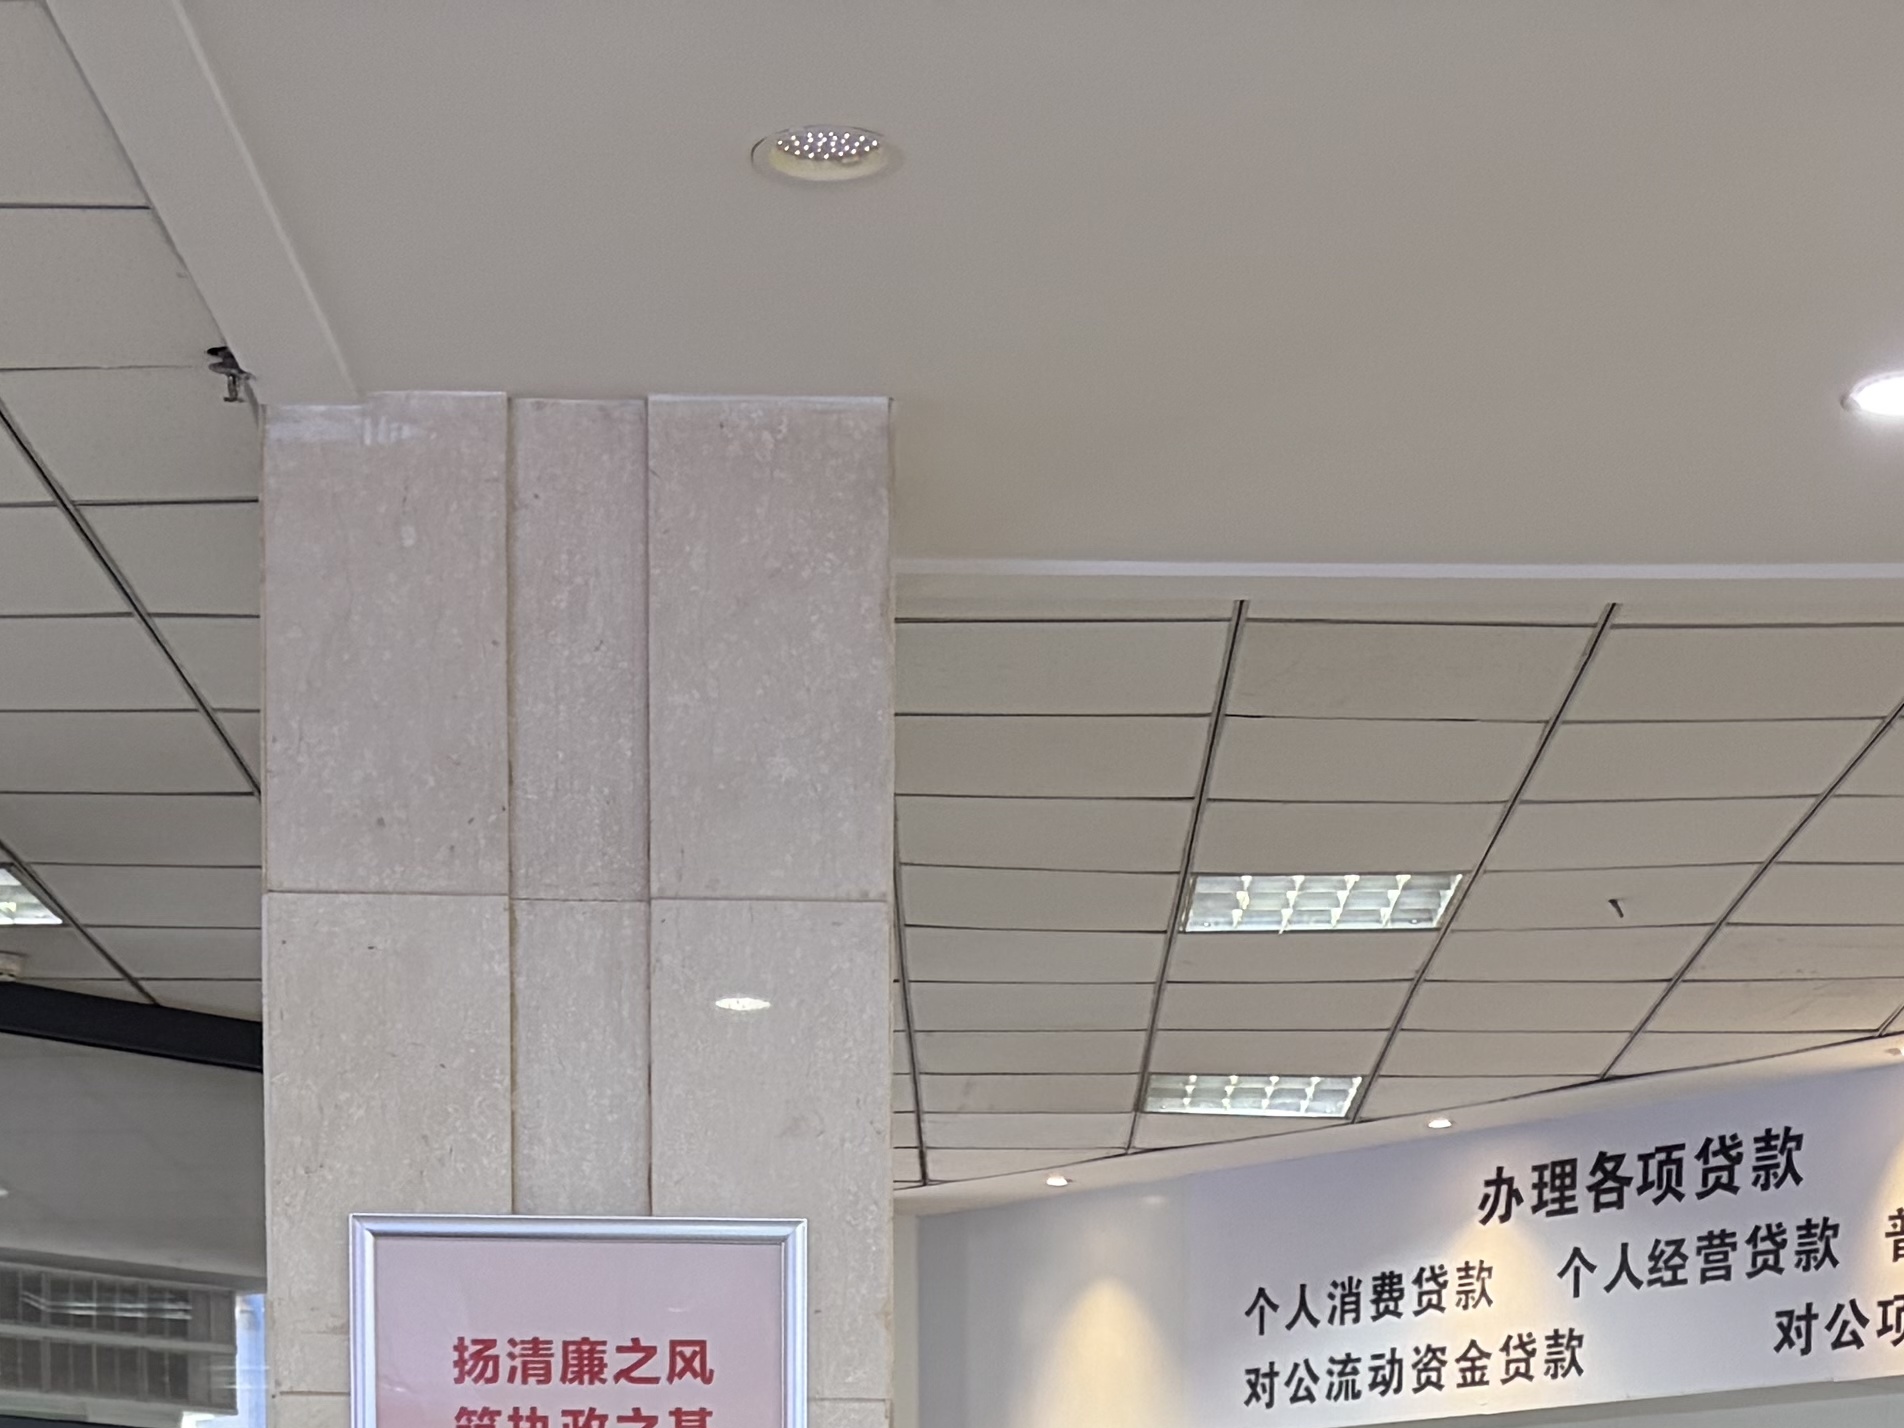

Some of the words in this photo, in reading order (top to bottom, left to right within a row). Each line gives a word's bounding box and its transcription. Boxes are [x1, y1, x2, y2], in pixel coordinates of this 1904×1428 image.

[1476, 1126, 1806, 1228] 办理各项贷款
[1243, 1260, 1495, 1337] 个人消费贷款
[1556, 1215, 1841, 1302] 个人经营贷款
[452, 1336, 715, 1387] 扬清廉之风
[1242, 1327, 1586, 1411] 对公流动资金贷款
